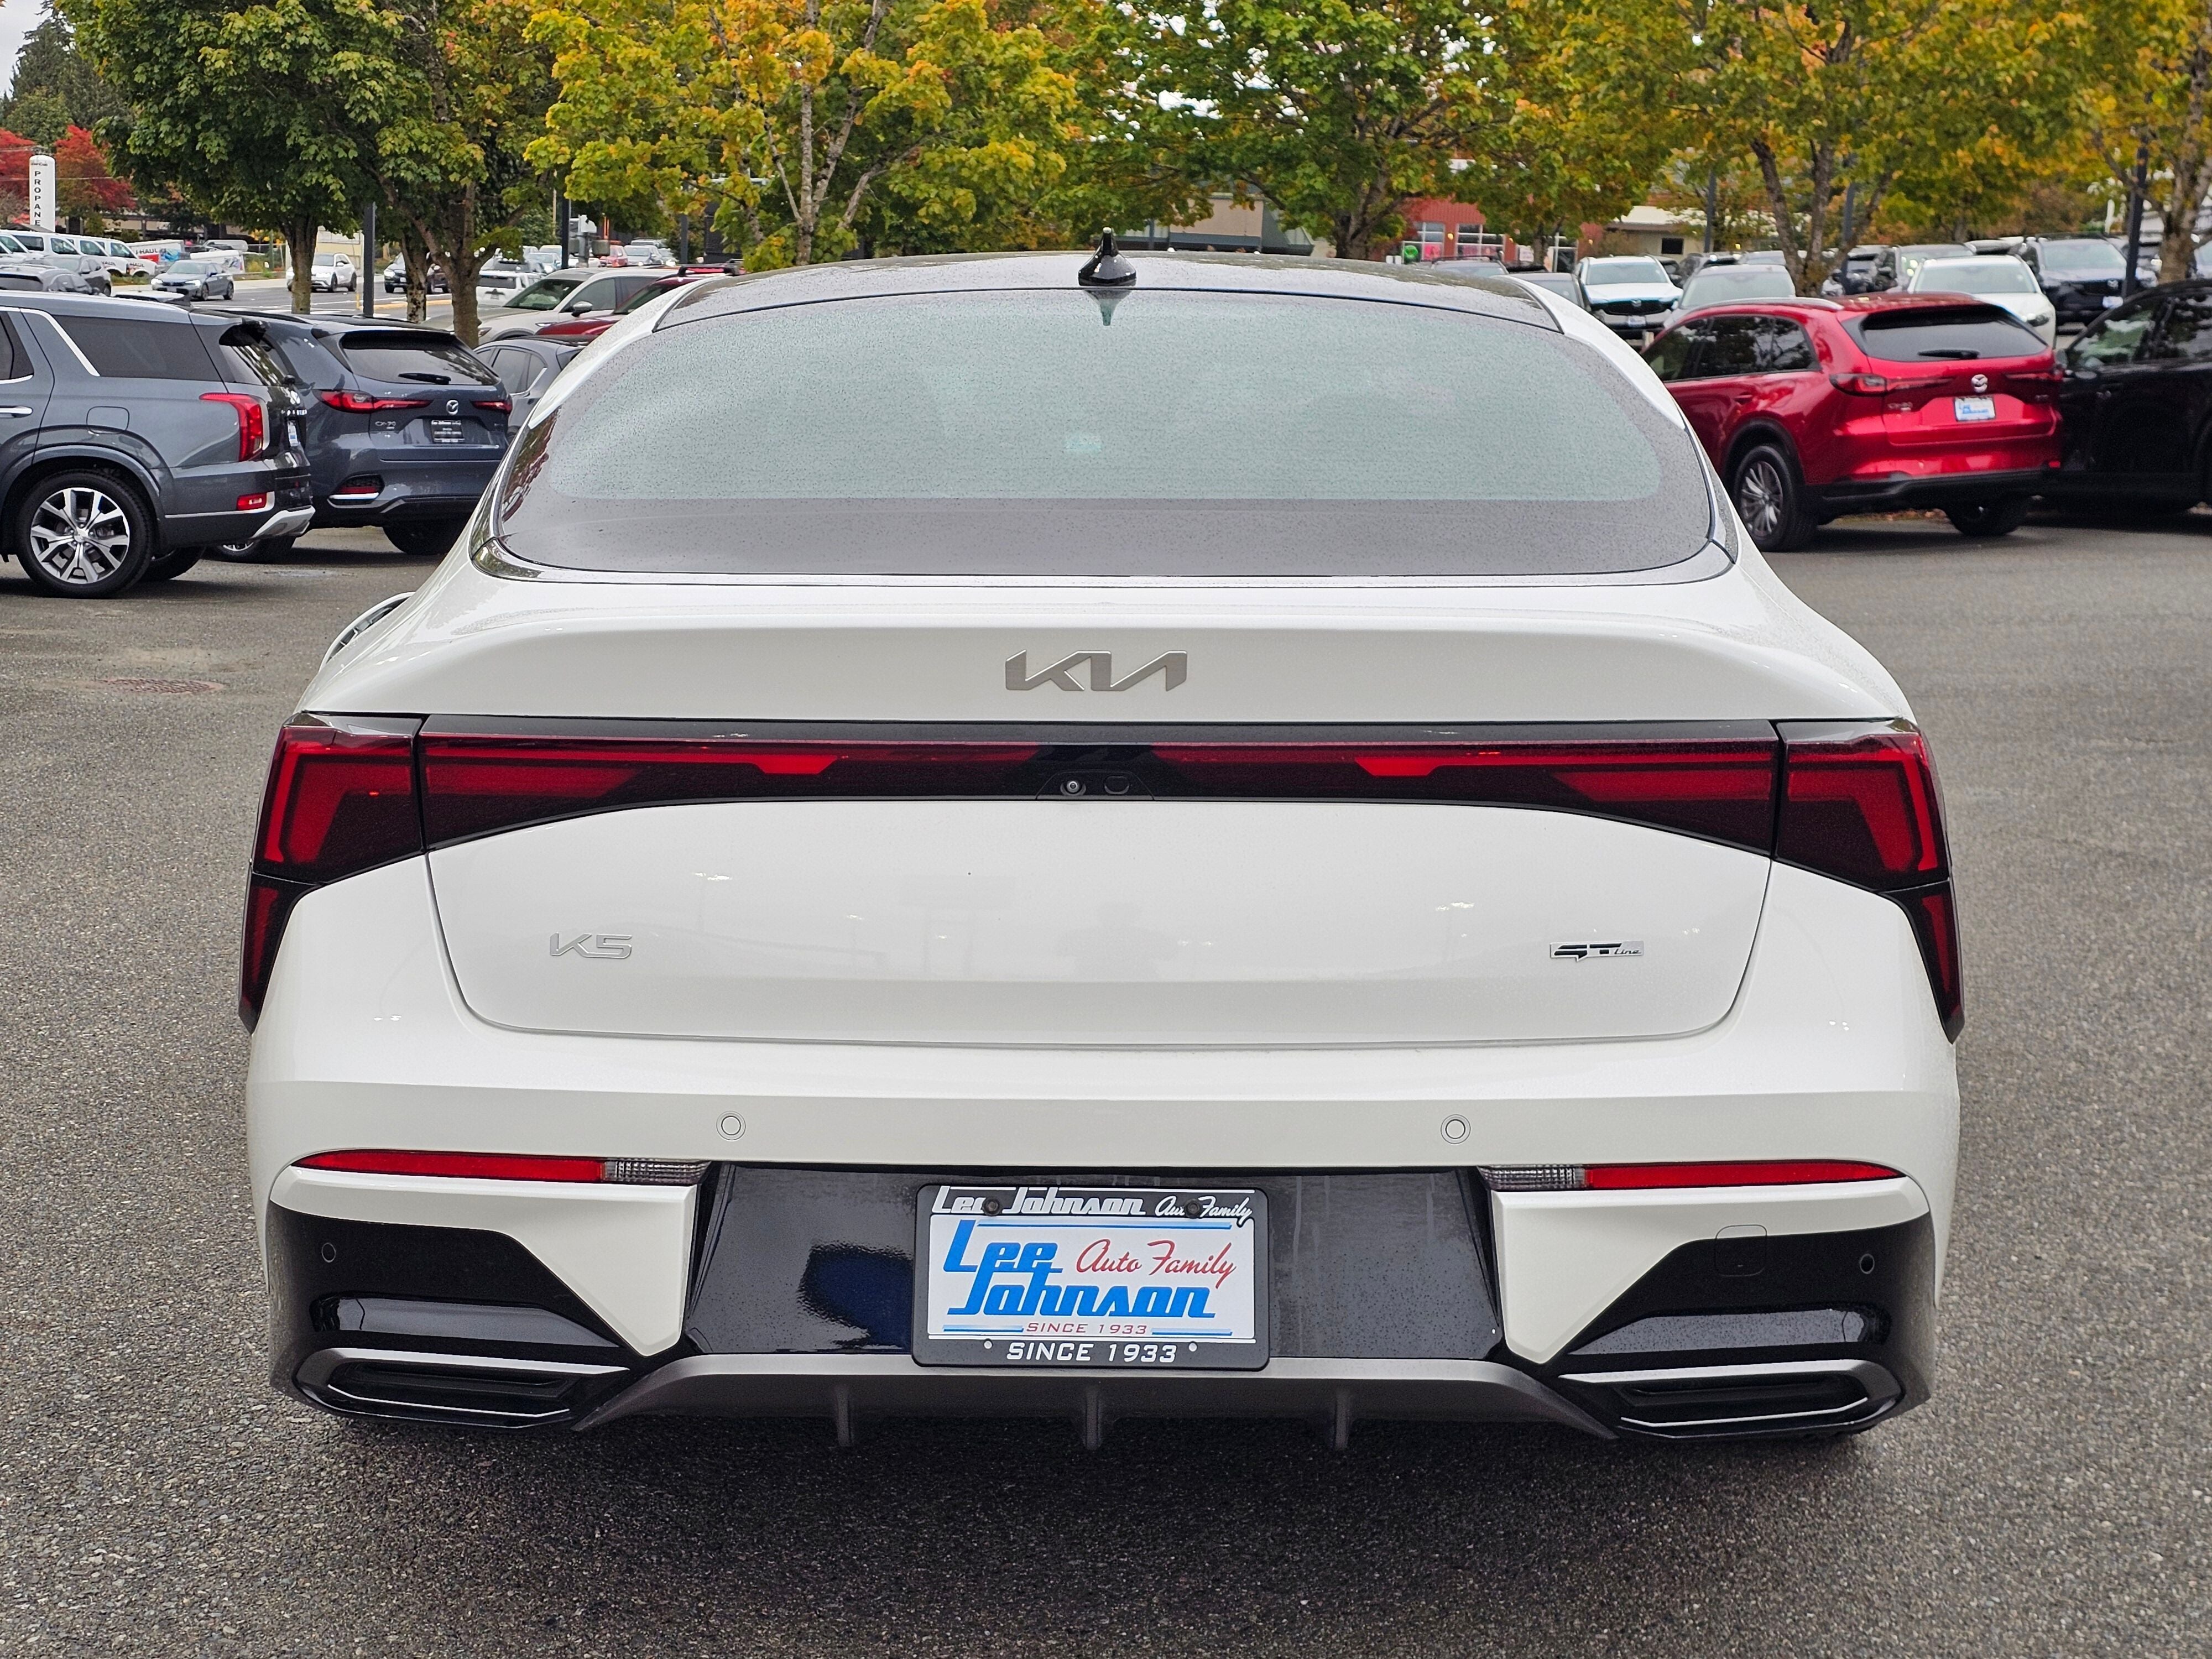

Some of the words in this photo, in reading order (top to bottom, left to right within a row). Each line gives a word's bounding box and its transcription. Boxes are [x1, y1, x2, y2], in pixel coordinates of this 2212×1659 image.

[1005, 650, 1187, 692] KIA
[550, 932, 632, 959] K5
[1001, 1187, 1146, 1215] Johnson
[1155, 1196, 1188, 1217] Aut
[1198, 1196, 1253, 1225] Family
[943, 1219, 1063, 1273] Lee
[1076, 1239, 1142, 1272] Auto
[1146, 1240, 1237, 1289] Family
[947, 1271, 1215, 1318] Johnson
[1026, 1322, 1088, 1333] SINCE
[1099, 1324, 1147, 1334] 1933
[1006, 1342, 1094, 1361] SINCE
[1109, 1344, 1177, 1363] 1933
